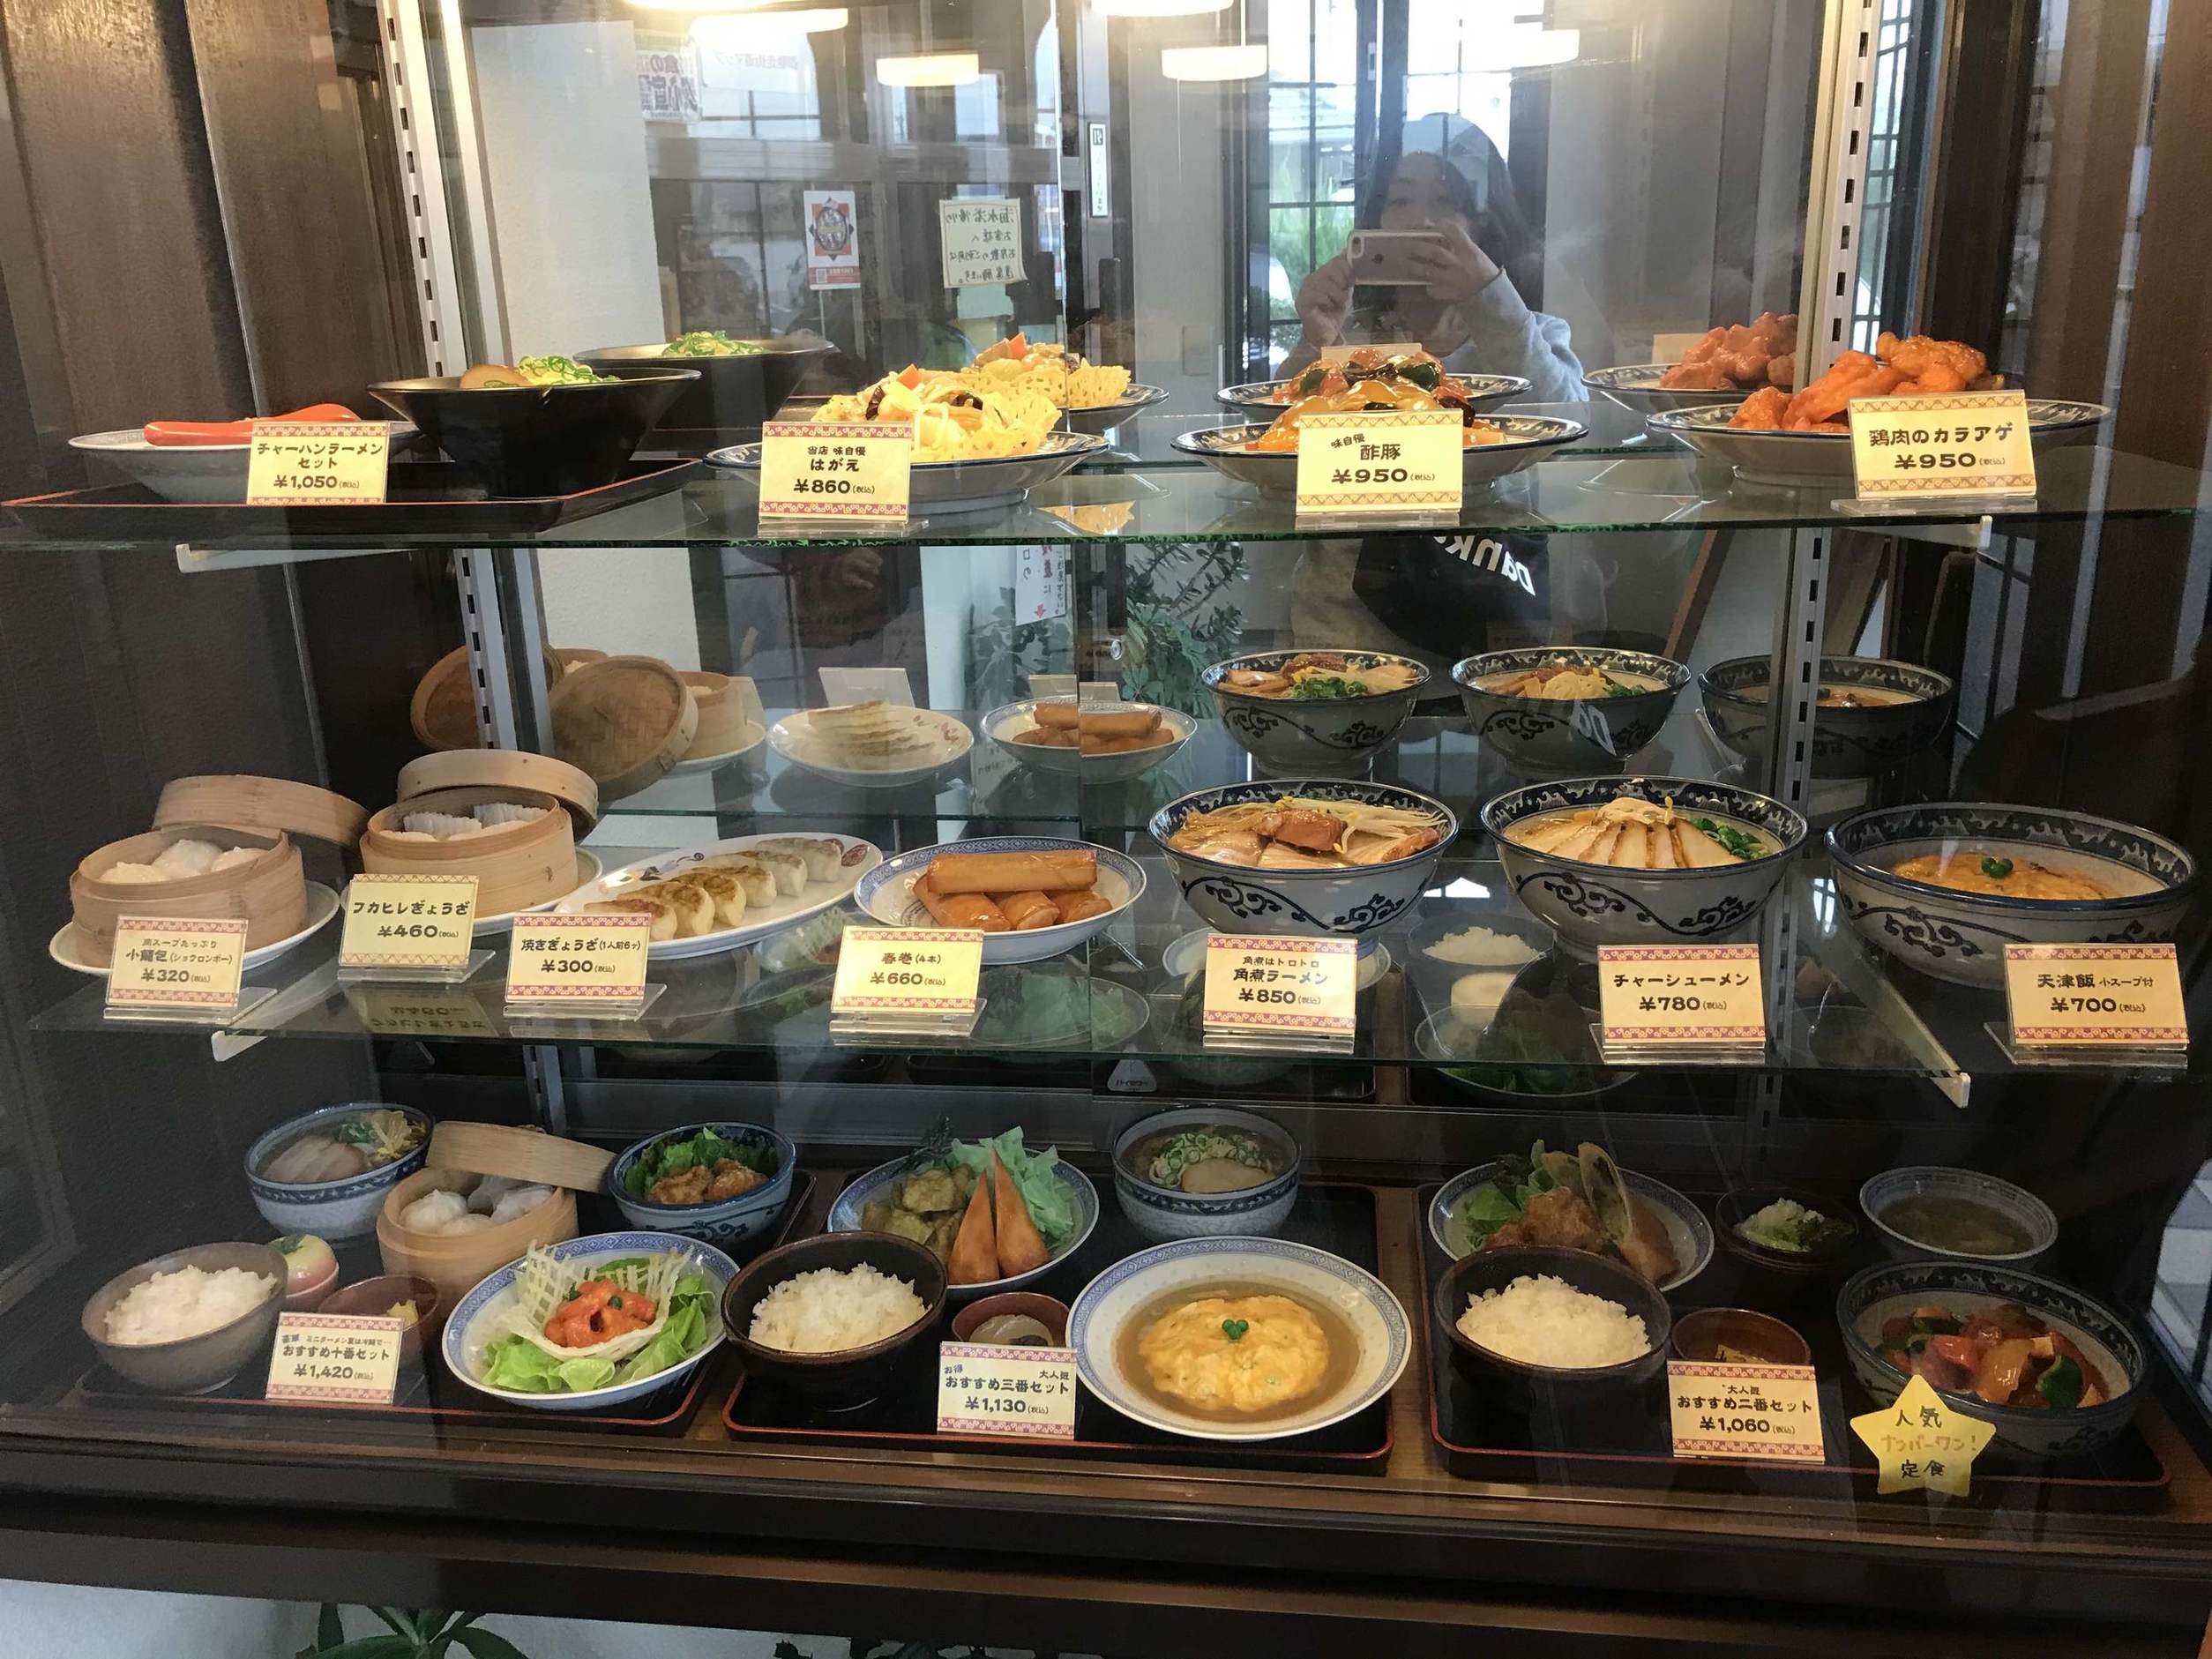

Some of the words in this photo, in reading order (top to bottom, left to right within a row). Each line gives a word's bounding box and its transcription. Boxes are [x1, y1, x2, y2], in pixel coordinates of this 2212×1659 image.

[1869, 422, 2013, 447] 鶏肉のカラアゲ
[257, 442, 383, 457] チャーハンラーメン
[807, 446, 829, 456] 当店
[1360, 444, 1401, 461] 酢豚
[298, 458, 338, 469] セット
[810, 459, 860, 473] はがえ
[353, 900, 470, 916] フカヒレぎょうざ
[1242, 956, 1319, 968] 角煮はトロトロ
[1233, 968, 1329, 984] 角煮ラーメン
[1612, 974, 1749, 988] チャーシューメン
[2036, 973, 2096, 990] 天津飯
[282, 1346, 389, 1362] おすすめ十番セット
[944, 1364, 963, 1374] お得
[945, 1376, 1070, 1394] おすすめ三番セット
[1677, 1395, 1812, 1413] おすすめ二番セット
[1895, 1404, 1942, 1428] 人気
[1901, 1460, 1946, 1479] 定食
